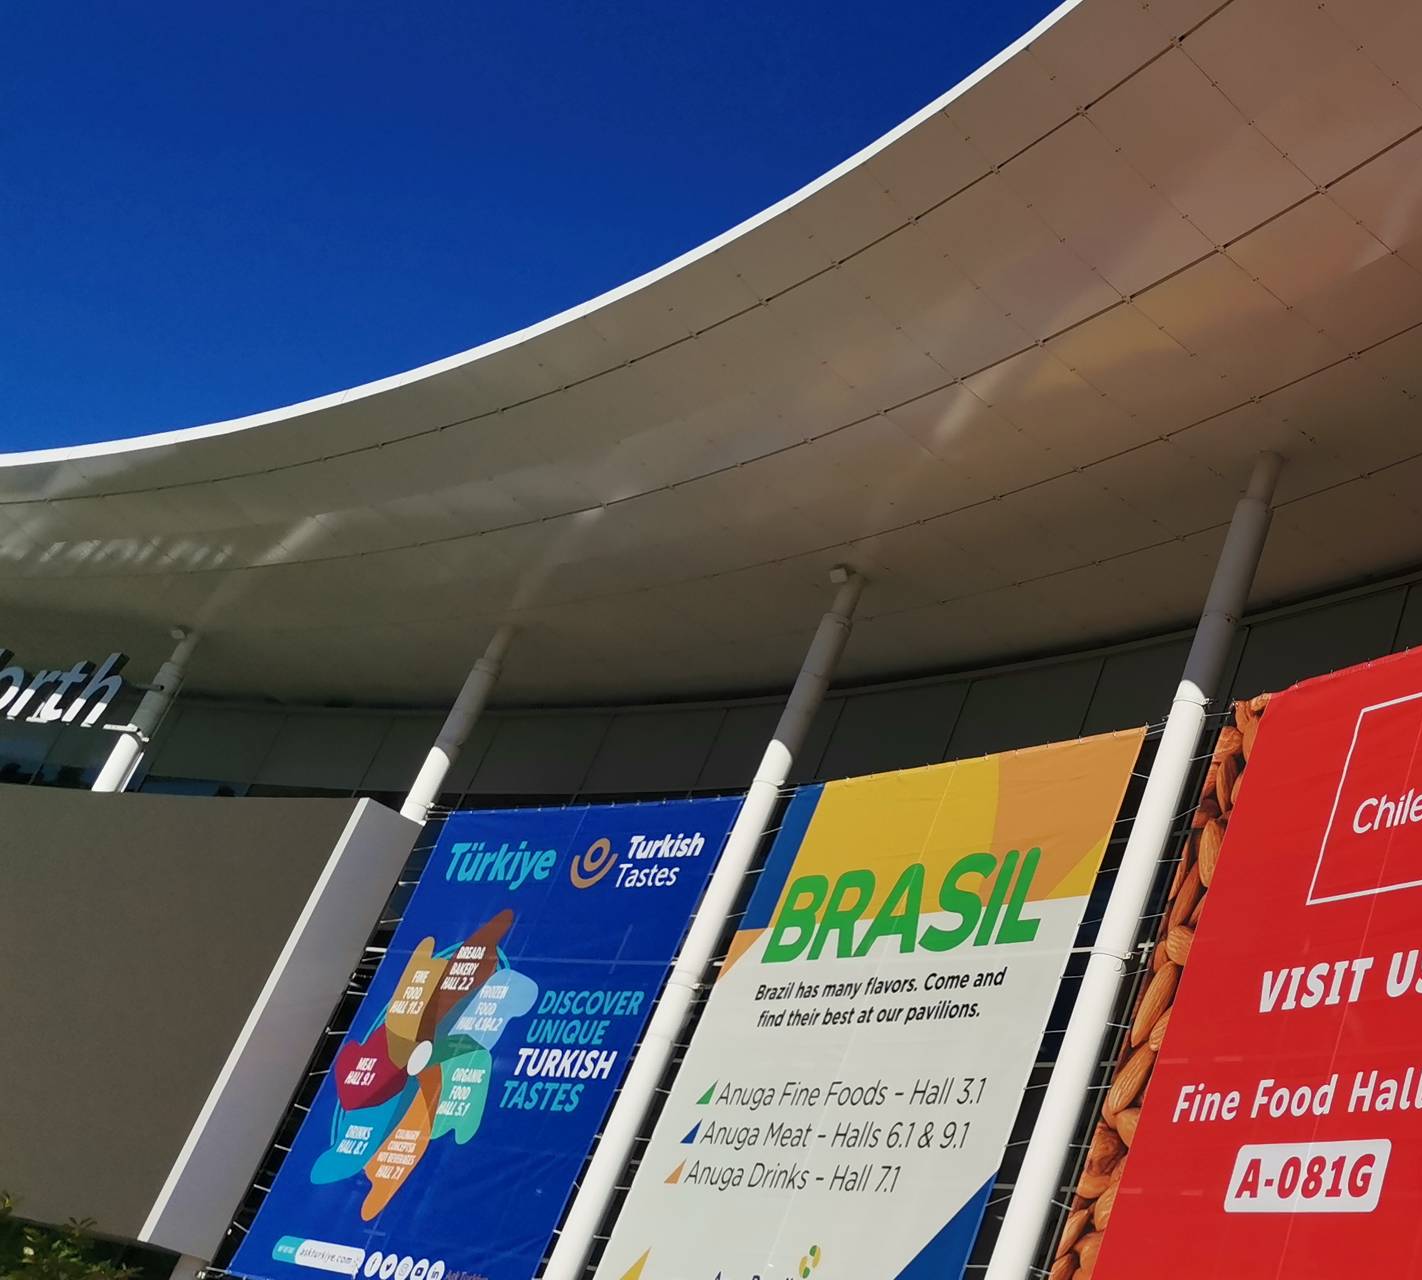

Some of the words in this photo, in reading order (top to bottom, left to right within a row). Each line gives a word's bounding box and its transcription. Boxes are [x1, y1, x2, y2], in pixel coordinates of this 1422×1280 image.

[0, 652, 123, 728] orth
[627, 832, 705, 860] Turkish
[445, 841, 557, 891] Türkiye
[615, 863, 680, 888] Tastes
[760, 846, 1042, 965] BRASIL
[449, 962, 480, 976] BAKERY
[402, 987, 423, 1001] FOOD
[440, 977, 459, 991] HALL
[458, 977, 475, 991] 2.2
[755, 981, 797, 1002] Brazil
[796, 979, 820, 1000] has
[821, 979, 861, 1002] many
[864, 976, 918, 997] flavors.
[924, 972, 970, 991] Come
[973, 966, 1008, 987] and
[1258, 956, 1374, 1014] VISIT
[389, 1001, 408, 1014] HALL
[474, 1002, 498, 1016] FOOD
[538, 990, 646, 1016] DISCOVER
[757, 1009, 785, 1028] find
[787, 1007, 820, 1027] their
[821, 1005, 854, 1026] best
[856, 1006, 875, 1024] at
[877, 1005, 904, 1023] our
[904, 1000, 981, 1026] pavilions.
[526, 1019, 610, 1046] UNIQUE
[356, 1058, 377, 1071] MEAT
[451, 1068, 486, 1083] ORGANIC
[513, 1048, 618, 1080] TURKISH
[344, 1072, 361, 1085] HALL
[448, 1086, 471, 1100] FOOD
[499, 1080, 584, 1113] TASTES
[715, 1081, 777, 1111] Anuga
[778, 1081, 821, 1106] Fine
[826, 1078, 889, 1107] Foods
[909, 1077, 954, 1106] Hall
[956, 1077, 988, 1106] 3.1
[1172, 1082, 1240, 1124] Fine
[1251, 1074, 1338, 1120] Food
[436, 1101, 456, 1115] HALL
[454, 1102, 471, 1117] 5.1
[336, 1140, 354, 1154] HALL
[699, 1121, 760, 1151] Anuga
[763, 1121, 812, 1149] Meat
[830, 1121, 882, 1149] Halls
[886, 1121, 915, 1149] 6.1
[917, 1121, 934, 1149] &
[939, 1121, 971, 1150] 9.1
[375, 1165, 394, 1179] HALL
[684, 1160, 745, 1190] Anuga
[747, 1162, 810, 1191] Drinks
[828, 1165, 872, 1192] Hall
[875, 1165, 902, 1193] 7.1
[1234, 1154, 1377, 1201] A-081G
